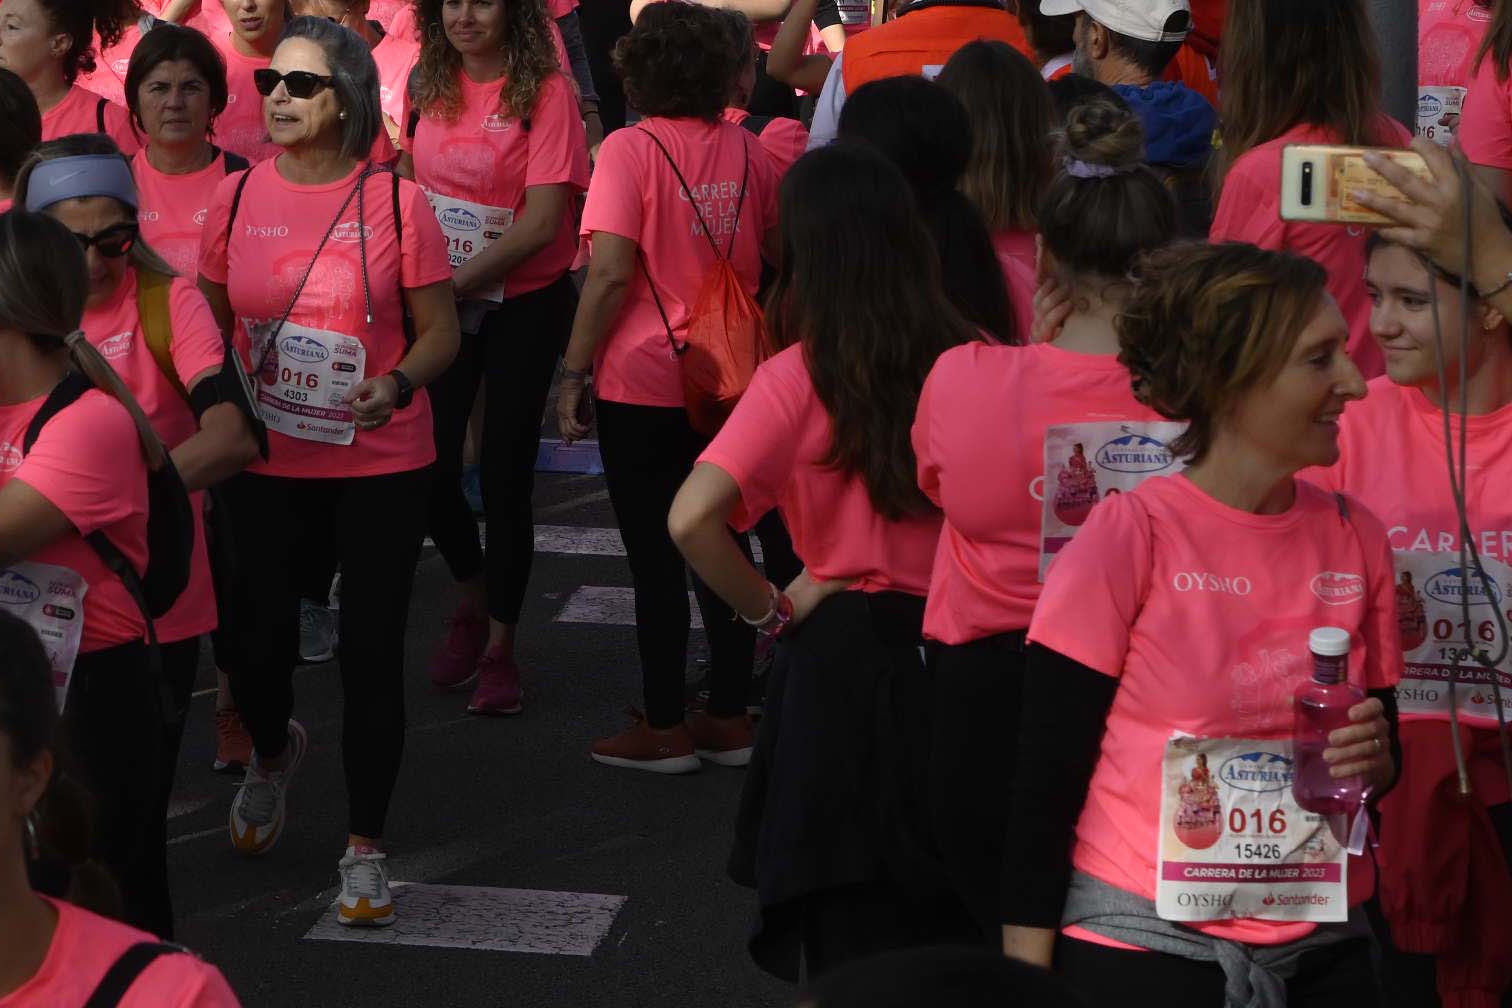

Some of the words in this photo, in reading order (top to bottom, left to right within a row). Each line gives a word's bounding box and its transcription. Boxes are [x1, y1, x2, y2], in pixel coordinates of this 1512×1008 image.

[719, 200, 738, 217] LA
[281, 367, 320, 389] 016
[307, 423, 345, 436] Santander
[1101, 446, 1169, 466] ASTURIANA
[1173, 571, 1252, 596] OYSHO
[1228, 807, 1287, 834] 016
[1235, 844, 1281, 860] 15426
[1184, 866, 1236, 878] CARRERA
[1238, 868, 1253, 879] DE
[1254, 869, 1268, 879] LA
[1269, 868, 1299, 878] MUJER
[1177, 892, 1234, 907] OYSHO
[1276, 893, 1330, 906] Santander
